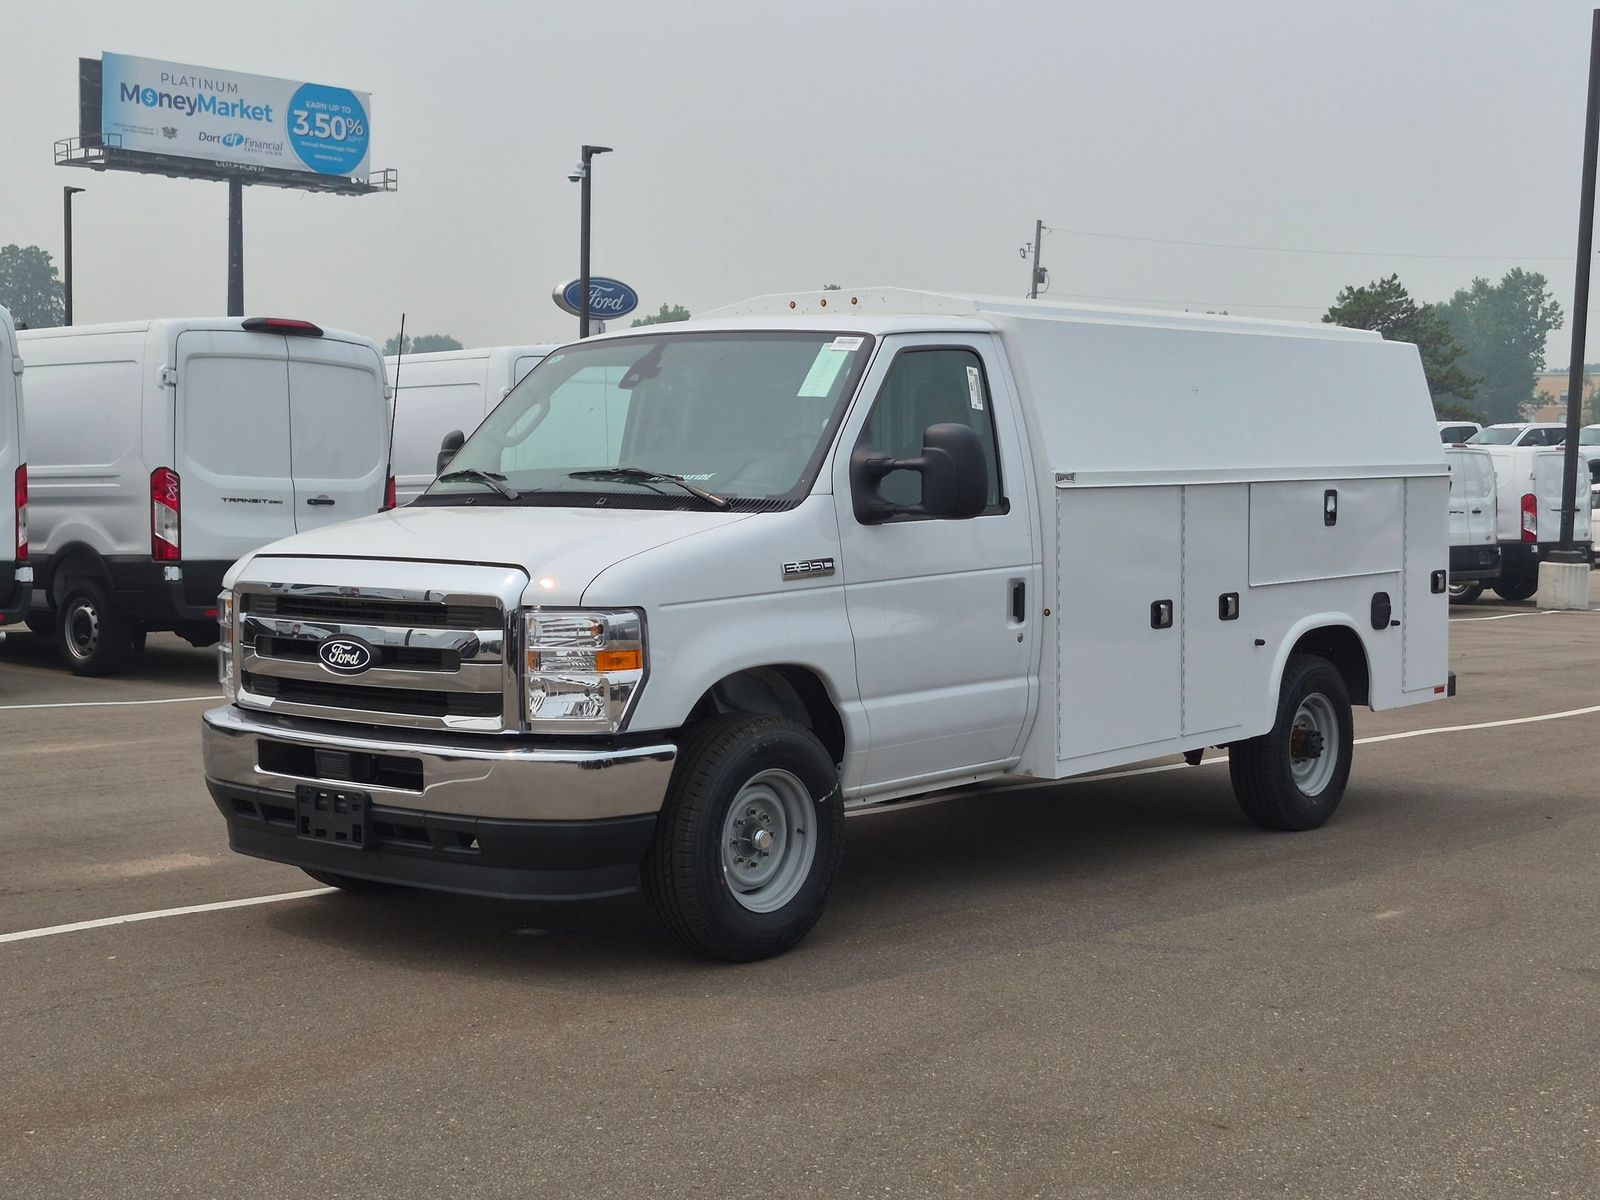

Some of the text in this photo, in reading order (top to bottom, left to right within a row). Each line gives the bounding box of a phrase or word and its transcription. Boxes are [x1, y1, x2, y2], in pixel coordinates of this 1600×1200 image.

[160, 72, 238, 94] PLATINUM
[305, 100, 352, 114] EARN UP TO
[292, 109, 364, 141] 3.50%
[198, 131, 221, 144] Dort
[244, 137, 284, 151] Financial
[783, 560, 833, 574] E-350
[328, 643, 361, 665] Ford
